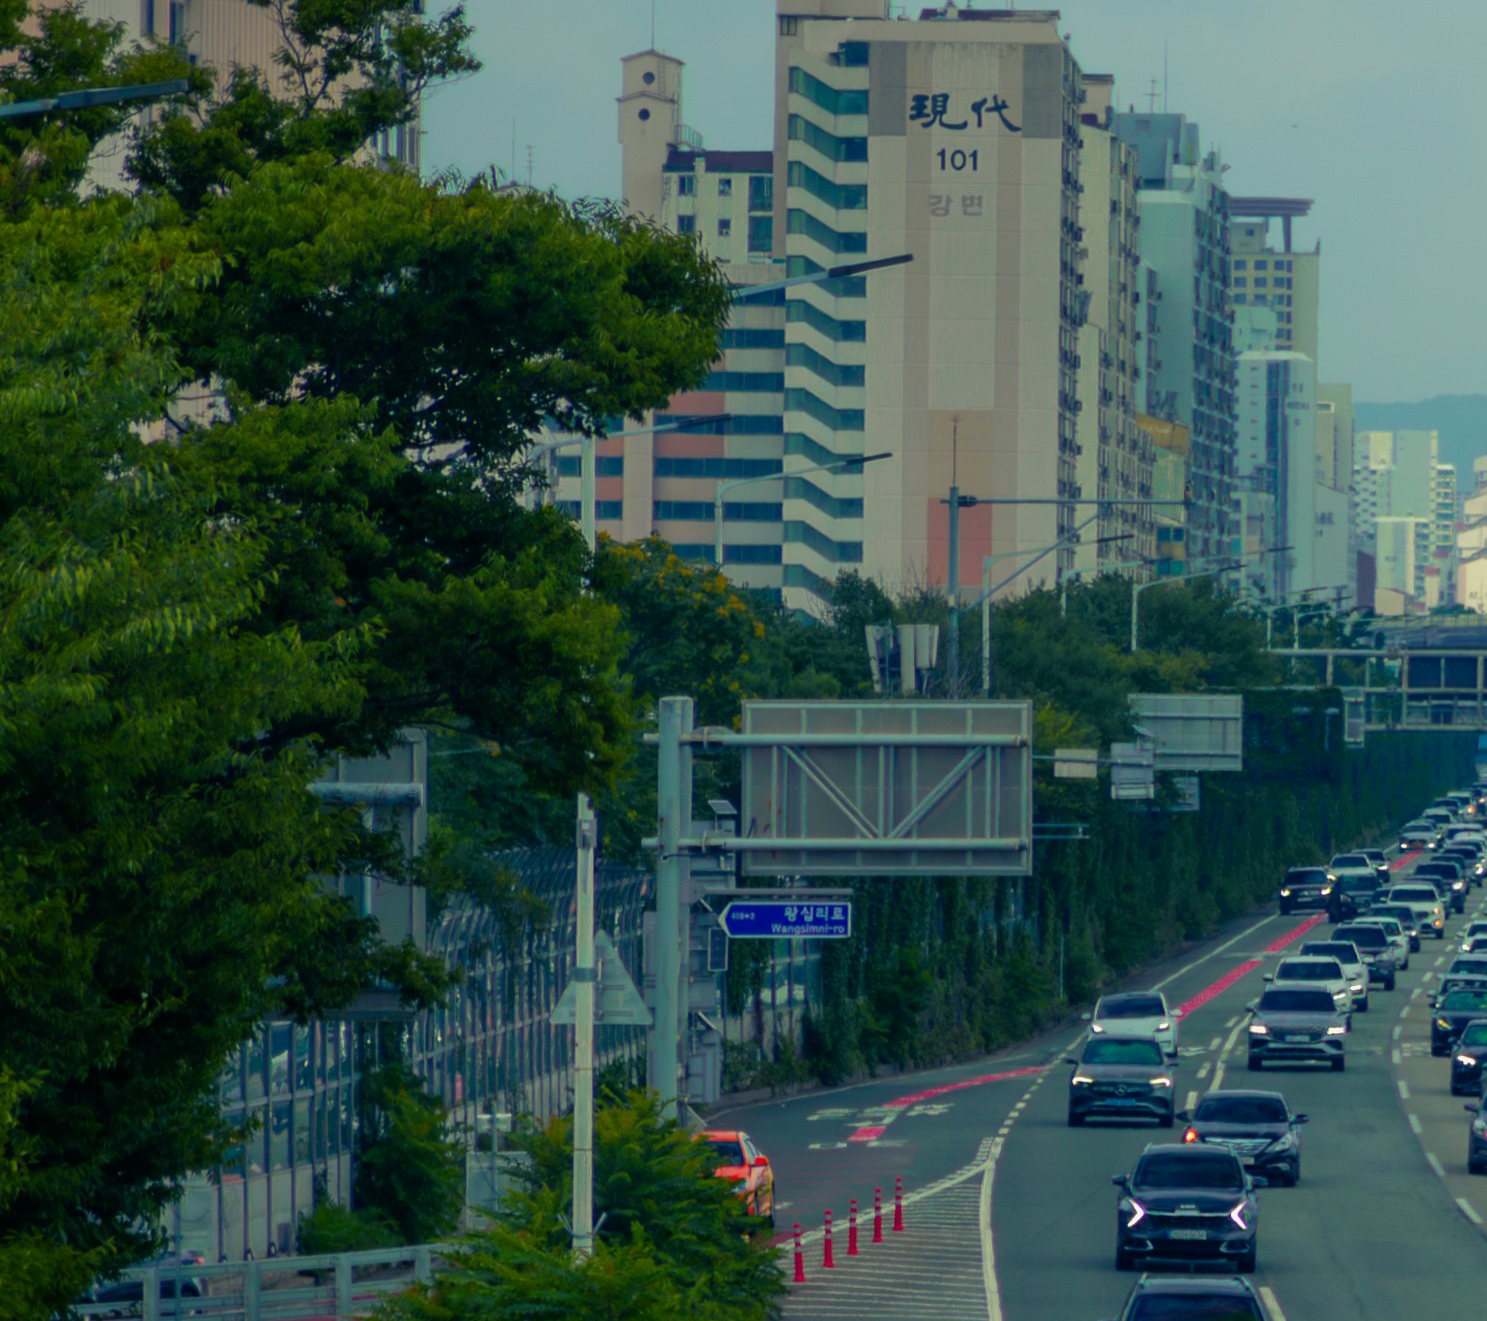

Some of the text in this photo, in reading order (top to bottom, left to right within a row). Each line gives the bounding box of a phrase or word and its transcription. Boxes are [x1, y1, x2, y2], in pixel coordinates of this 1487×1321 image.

[909, 93, 1022, 132] 現代
[937, 148, 978, 171] 101
[928, 195, 982, 217] 강변
[784, 906, 845, 922] 왕십리로
[771, 923, 845, 935] Wangsimni-ro
